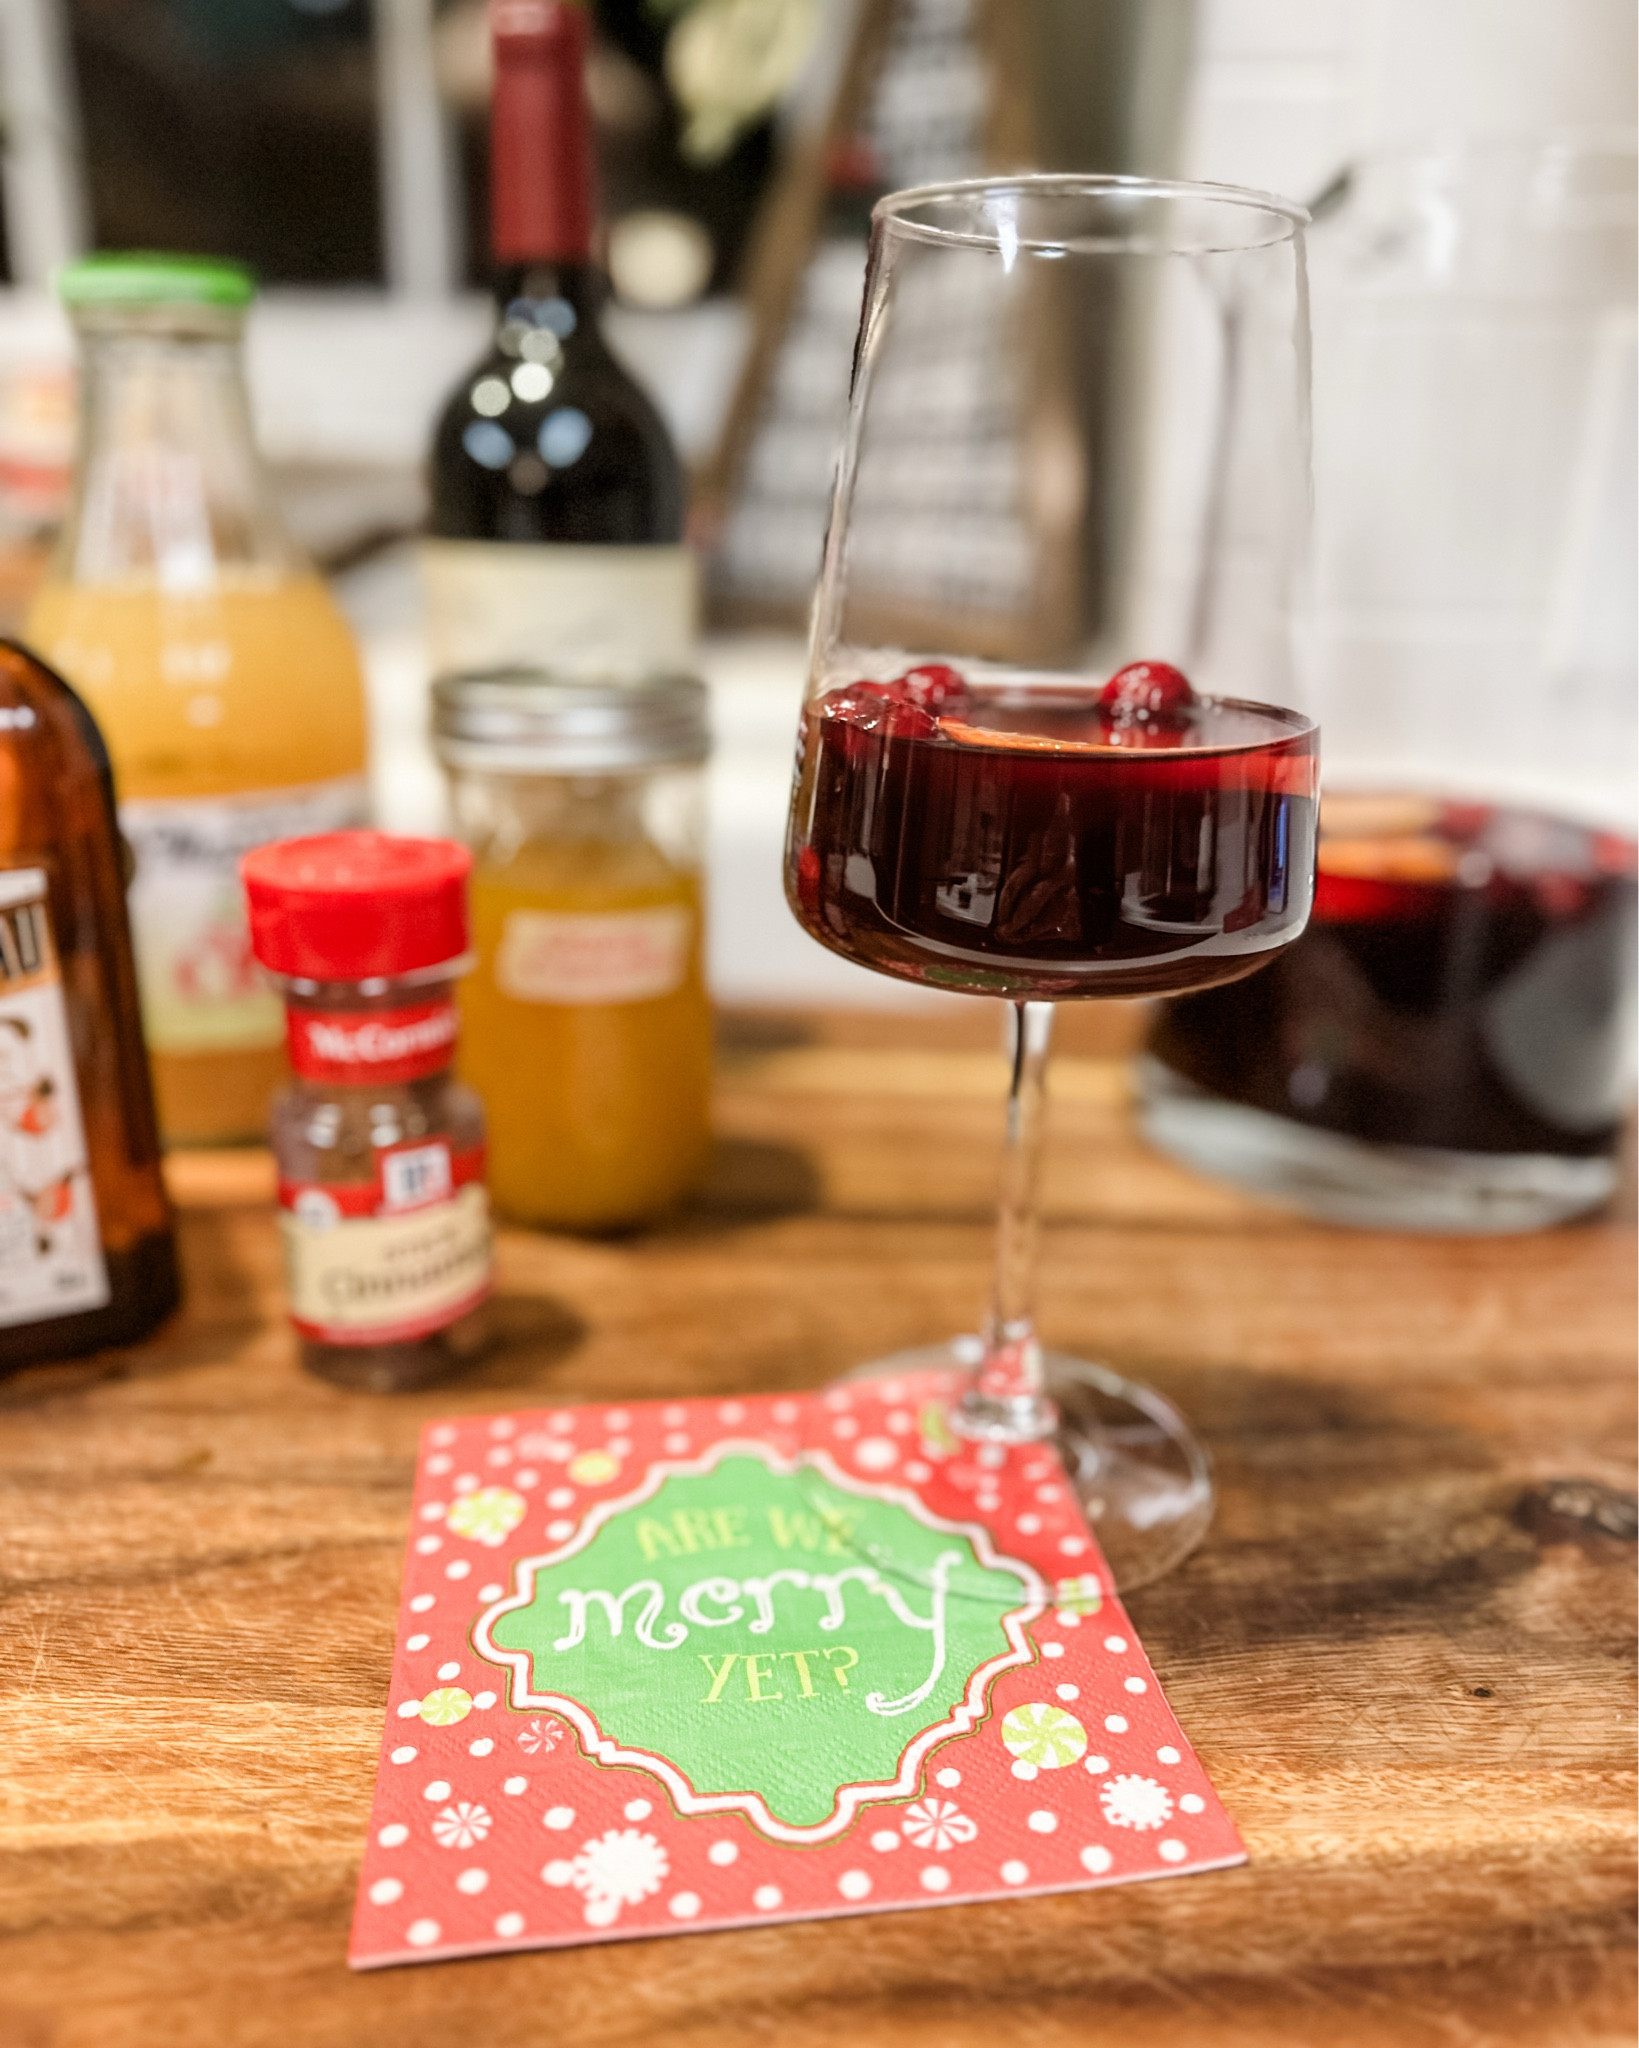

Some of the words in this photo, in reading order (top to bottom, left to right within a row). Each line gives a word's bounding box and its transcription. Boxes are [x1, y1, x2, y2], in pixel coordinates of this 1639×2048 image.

[634, 1503, 751, 1563] ARE
[768, 1503, 866, 1557] WE
[553, 1551, 963, 1716] merry
[697, 1646, 859, 1703] YET?
